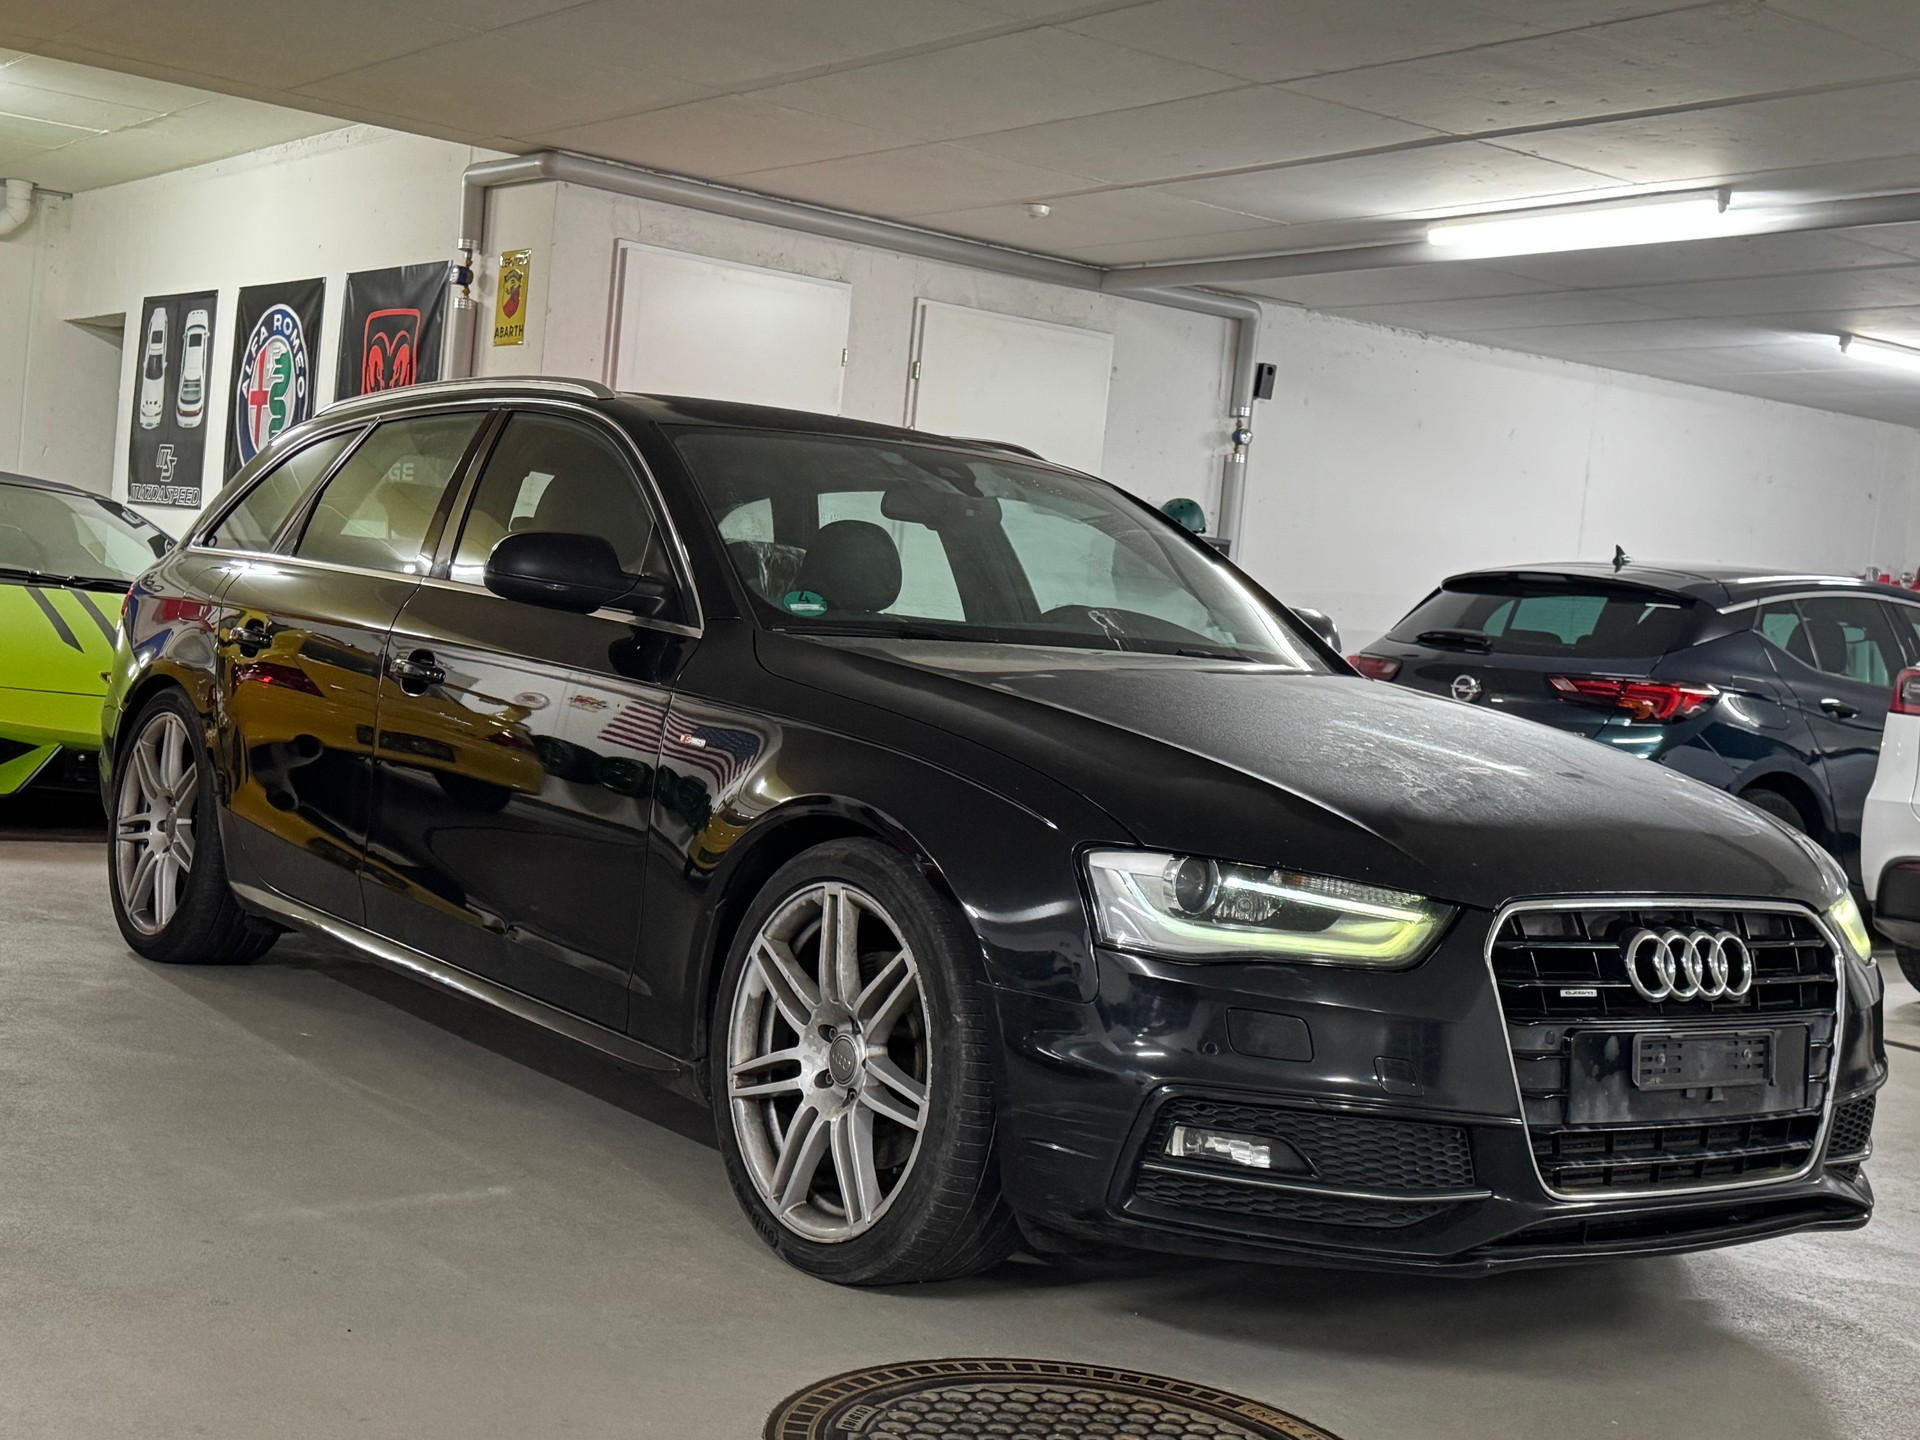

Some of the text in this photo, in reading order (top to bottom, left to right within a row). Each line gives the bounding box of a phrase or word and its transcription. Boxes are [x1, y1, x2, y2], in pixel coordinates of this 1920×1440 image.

[494, 325, 524, 338] ABARTH
[242, 314, 305, 399] ALFA ROMEO
[130, 483, 201, 506] MAZDASPEED
[798, 591, 810, 603] 4
